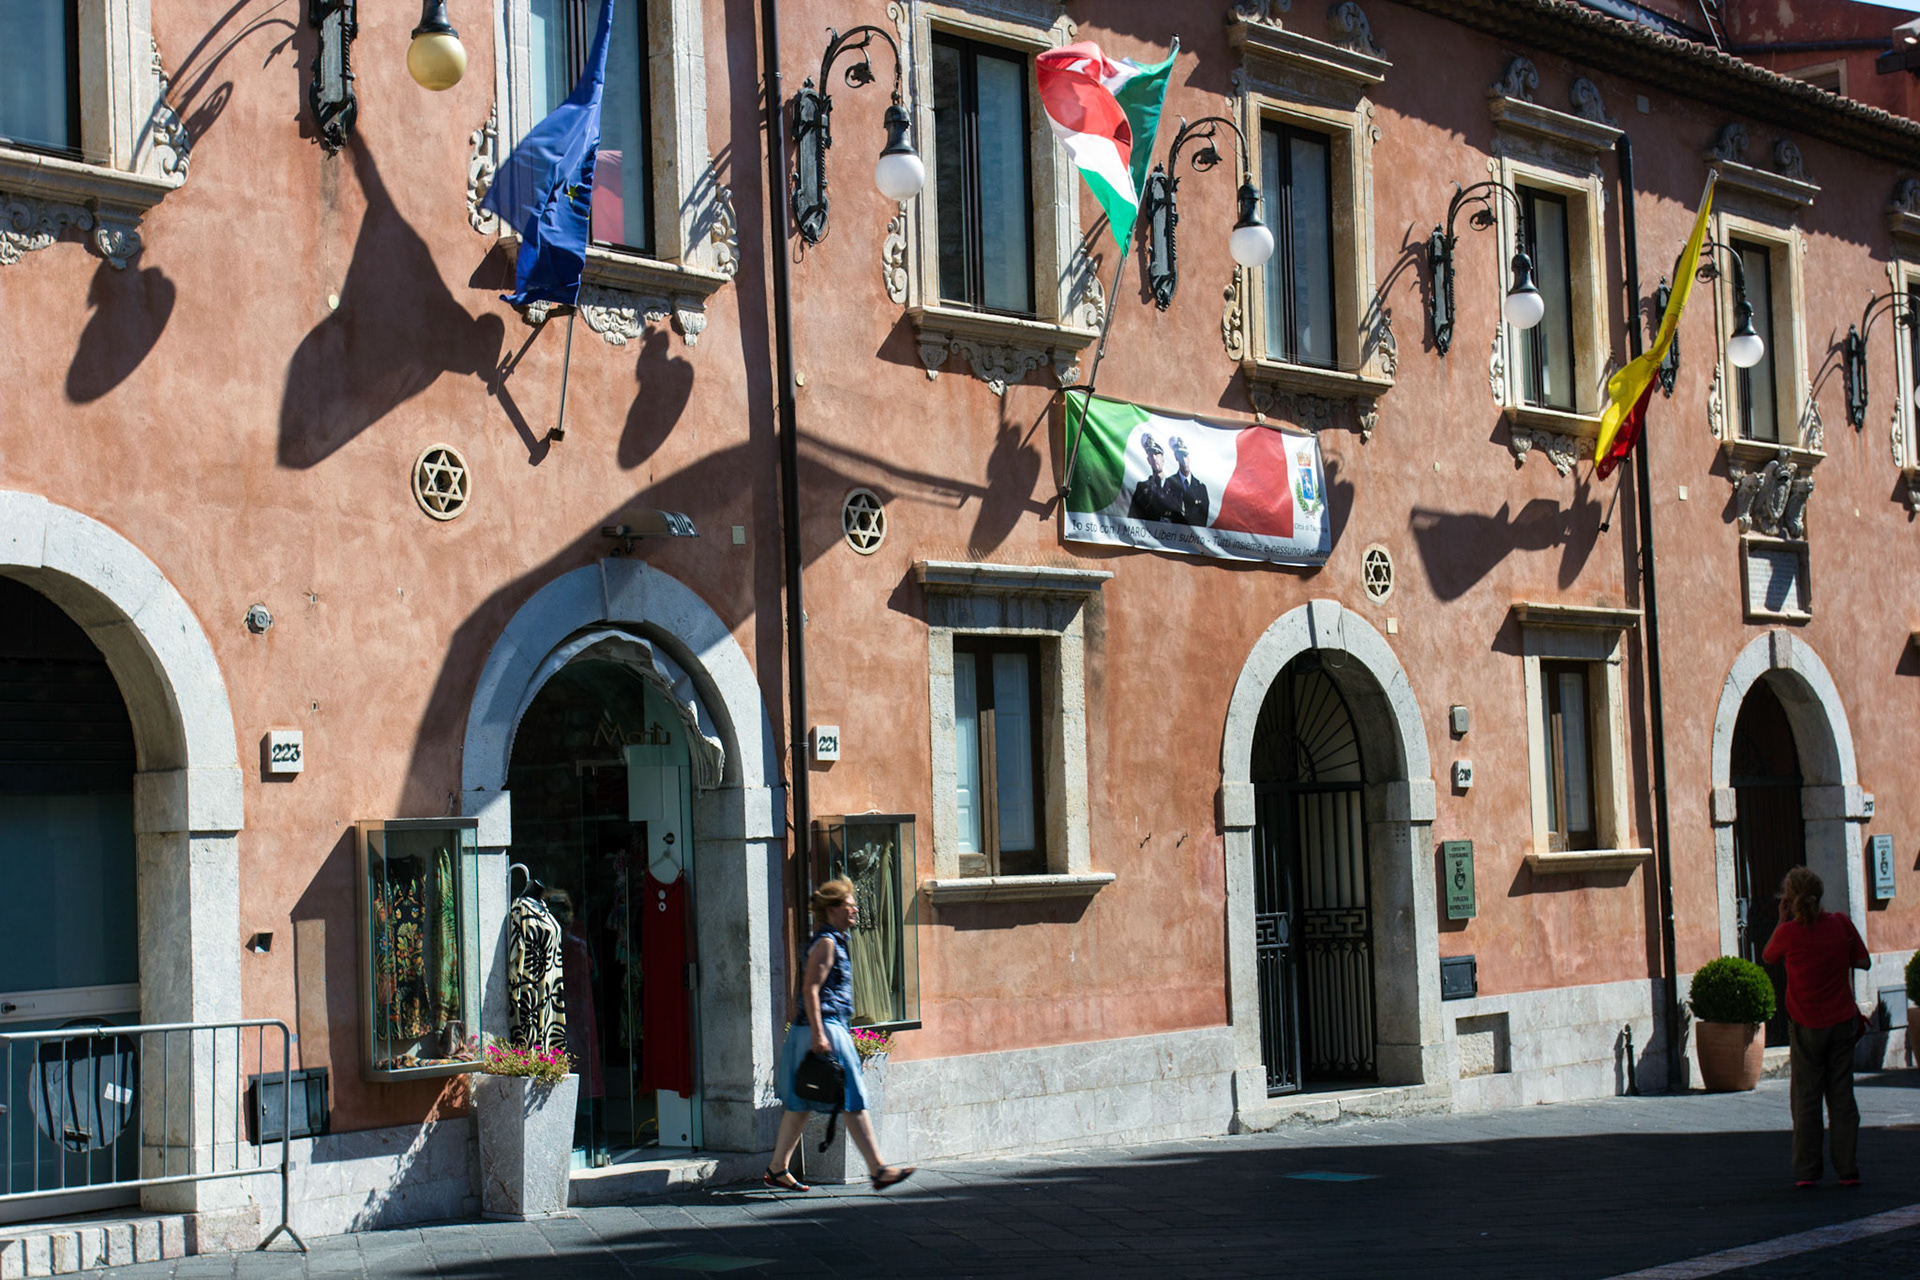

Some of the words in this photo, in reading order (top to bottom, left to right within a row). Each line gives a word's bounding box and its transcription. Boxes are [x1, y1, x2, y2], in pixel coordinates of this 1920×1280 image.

[1072, 519, 1083, 531] Io
[1085, 521, 1098, 532] sto
[1100, 523, 1114, 535] con
[1154, 528, 1177, 541] Liberi
[1178, 532, 1205, 547] subito
[1213, 536, 1231, 547] Tutti
[1232, 539, 1262, 551] insieme
[1264, 545, 1269, 553] e
[1270, 545, 1301, 556] nessuno
[272, 743, 301, 762] 223
[818, 736, 838, 752] 221
